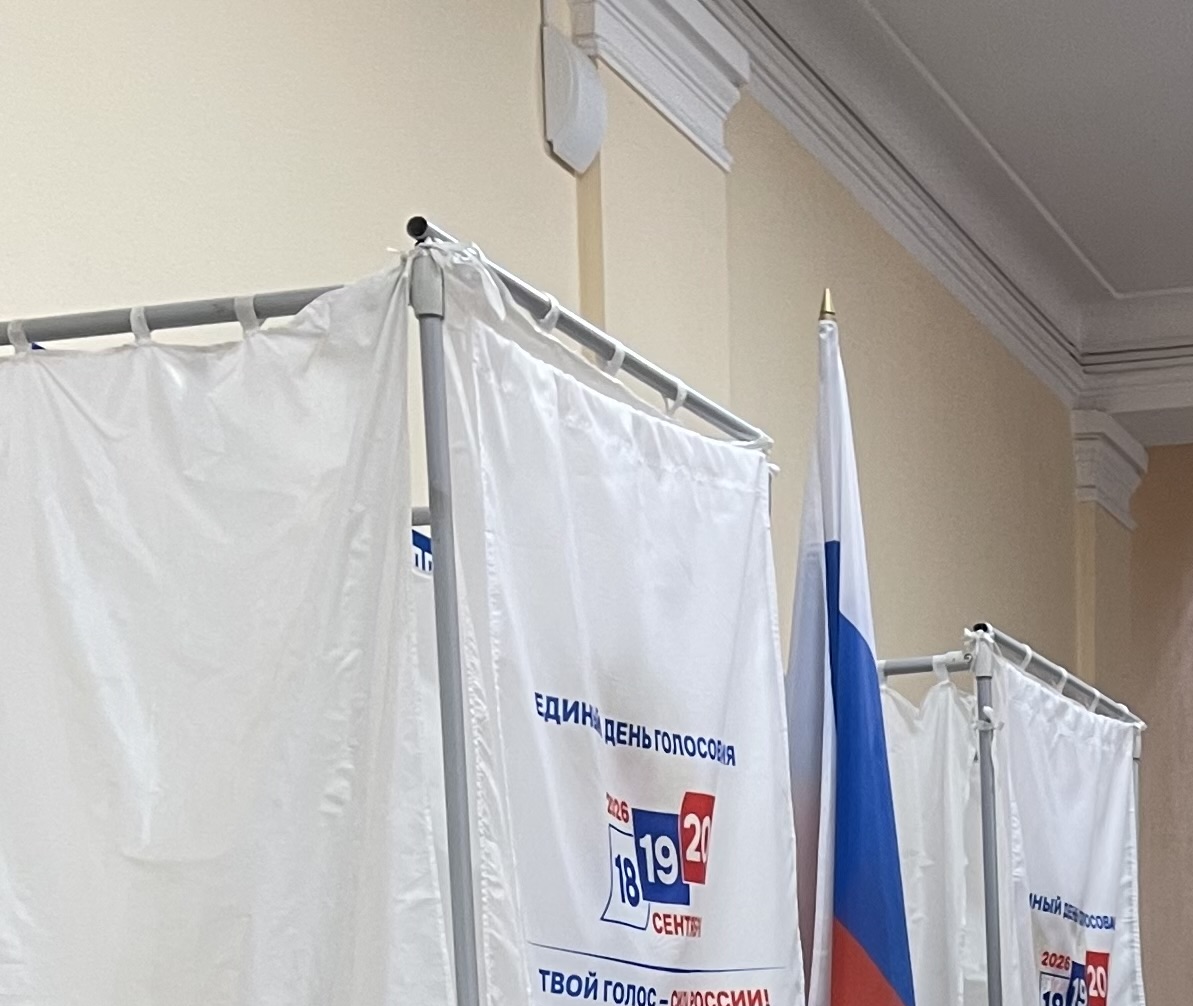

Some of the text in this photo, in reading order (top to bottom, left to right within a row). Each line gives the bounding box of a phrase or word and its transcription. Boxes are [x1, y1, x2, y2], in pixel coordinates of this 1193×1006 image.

[605, 718, 652, 750] ДЕНЬ
[615, 813, 711, 907] 18 19 20
[1041, 951, 1071, 971] 2026
[538, 968, 598, 1001] ТВОЙ
[1087, 965, 1107, 998] 20
